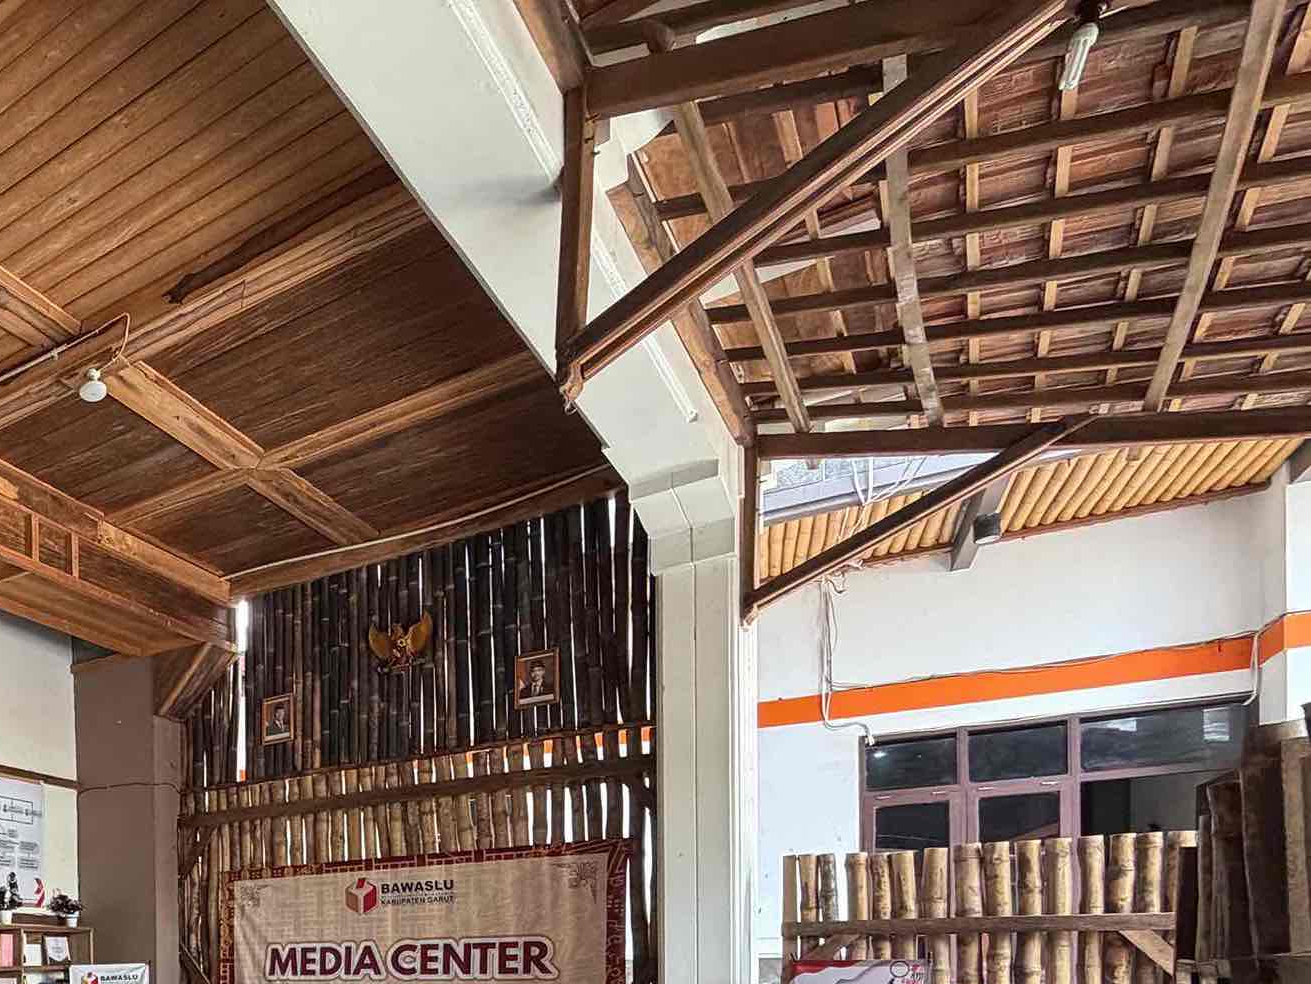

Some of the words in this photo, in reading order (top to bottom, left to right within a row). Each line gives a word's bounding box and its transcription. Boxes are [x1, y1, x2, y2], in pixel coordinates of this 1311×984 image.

[380, 879, 454, 895] BAWASLU
[267, 943, 382, 978] MEDIA
[389, 940, 554, 977] CENTER
